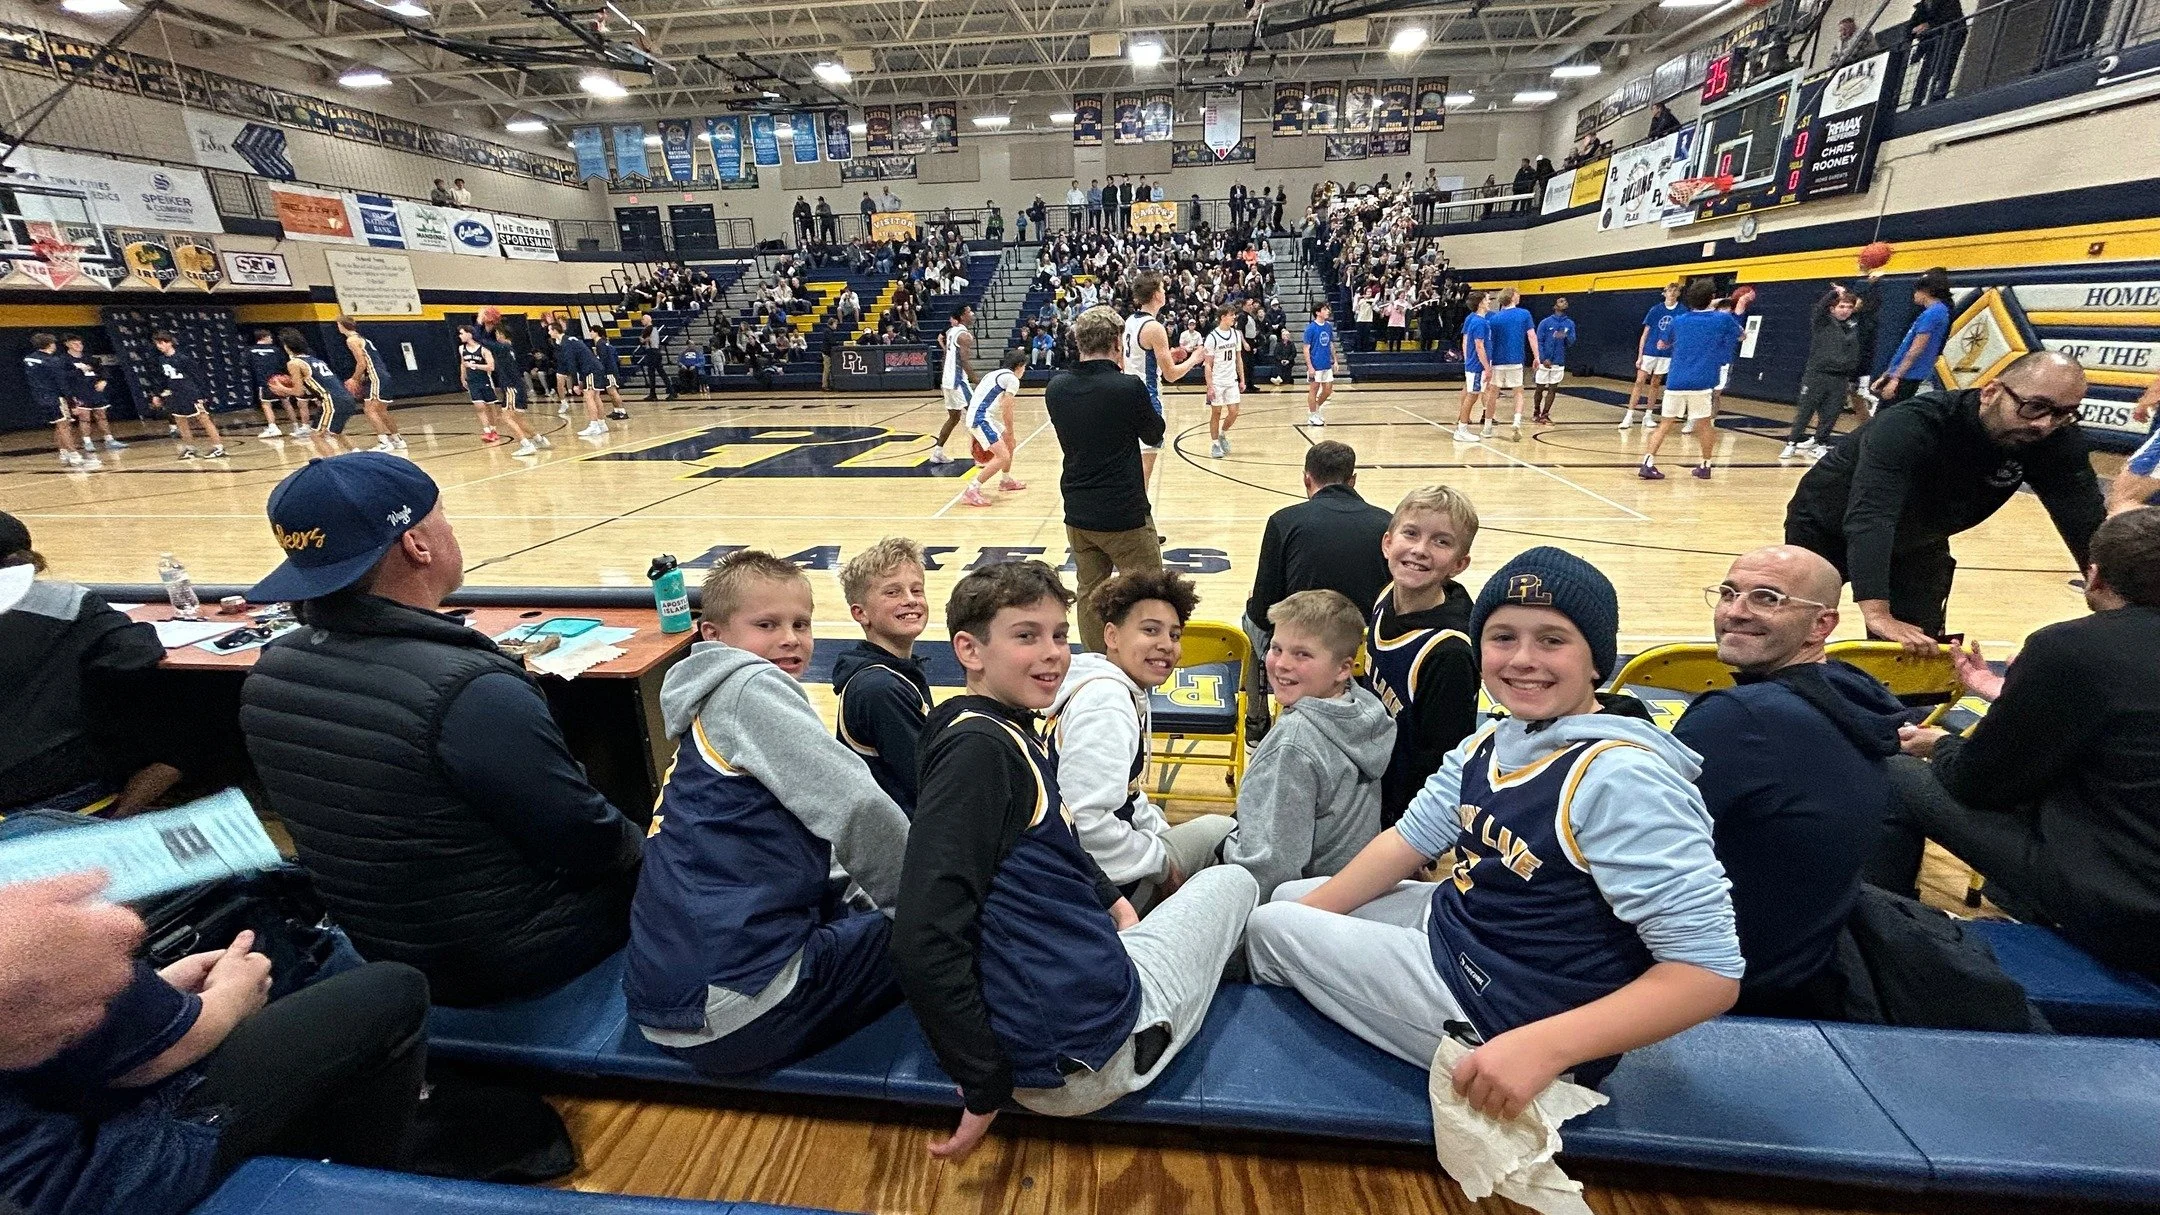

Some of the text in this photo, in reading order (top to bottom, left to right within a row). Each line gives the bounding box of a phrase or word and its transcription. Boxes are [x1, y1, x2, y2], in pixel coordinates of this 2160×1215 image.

[51, 42, 131, 72] LAKRS
[1704, 57, 1731, 98] 35
[1836, 61, 1877, 93] PLAY
[1275, 88, 1304, 100] LAKERS
[1382, 84, 1411, 97] LAKERS
[1418, 82, 1447, 95] LAKERS
[1795, 131, 1809, 158] 0
[1821, 141, 1855, 158] CHRIS
[1720, 154, 1732, 176] 0
[1812, 153, 1858, 172] ROONEY
[1788, 170, 1800, 190] 0
[141, 193, 192, 207] SPEIKER
[154, 204, 194, 215] COMPANY
[1132, 205, 1175, 221] LAKERS
[364, 217, 397, 228] NATIONAL
[497, 223, 515, 233] THE
[873, 217, 913, 229] VISITOR
[500, 234, 552, 248] SPORTSMAN
[83, 266, 127, 279] SABERS
[136, 268, 178, 280] IRISH
[185, 270, 223, 282] EAGLES
[2084, 286, 2160, 307] HOME
[842, 350, 868, 375] PL
[1224, 349, 1233, 361] 10
[2098, 346, 2151, 367] THE
[1507, 573, 1553, 606] PL
[662, 596, 688, 608] APOSTL
[1481, 813, 1545, 882] LAKE
